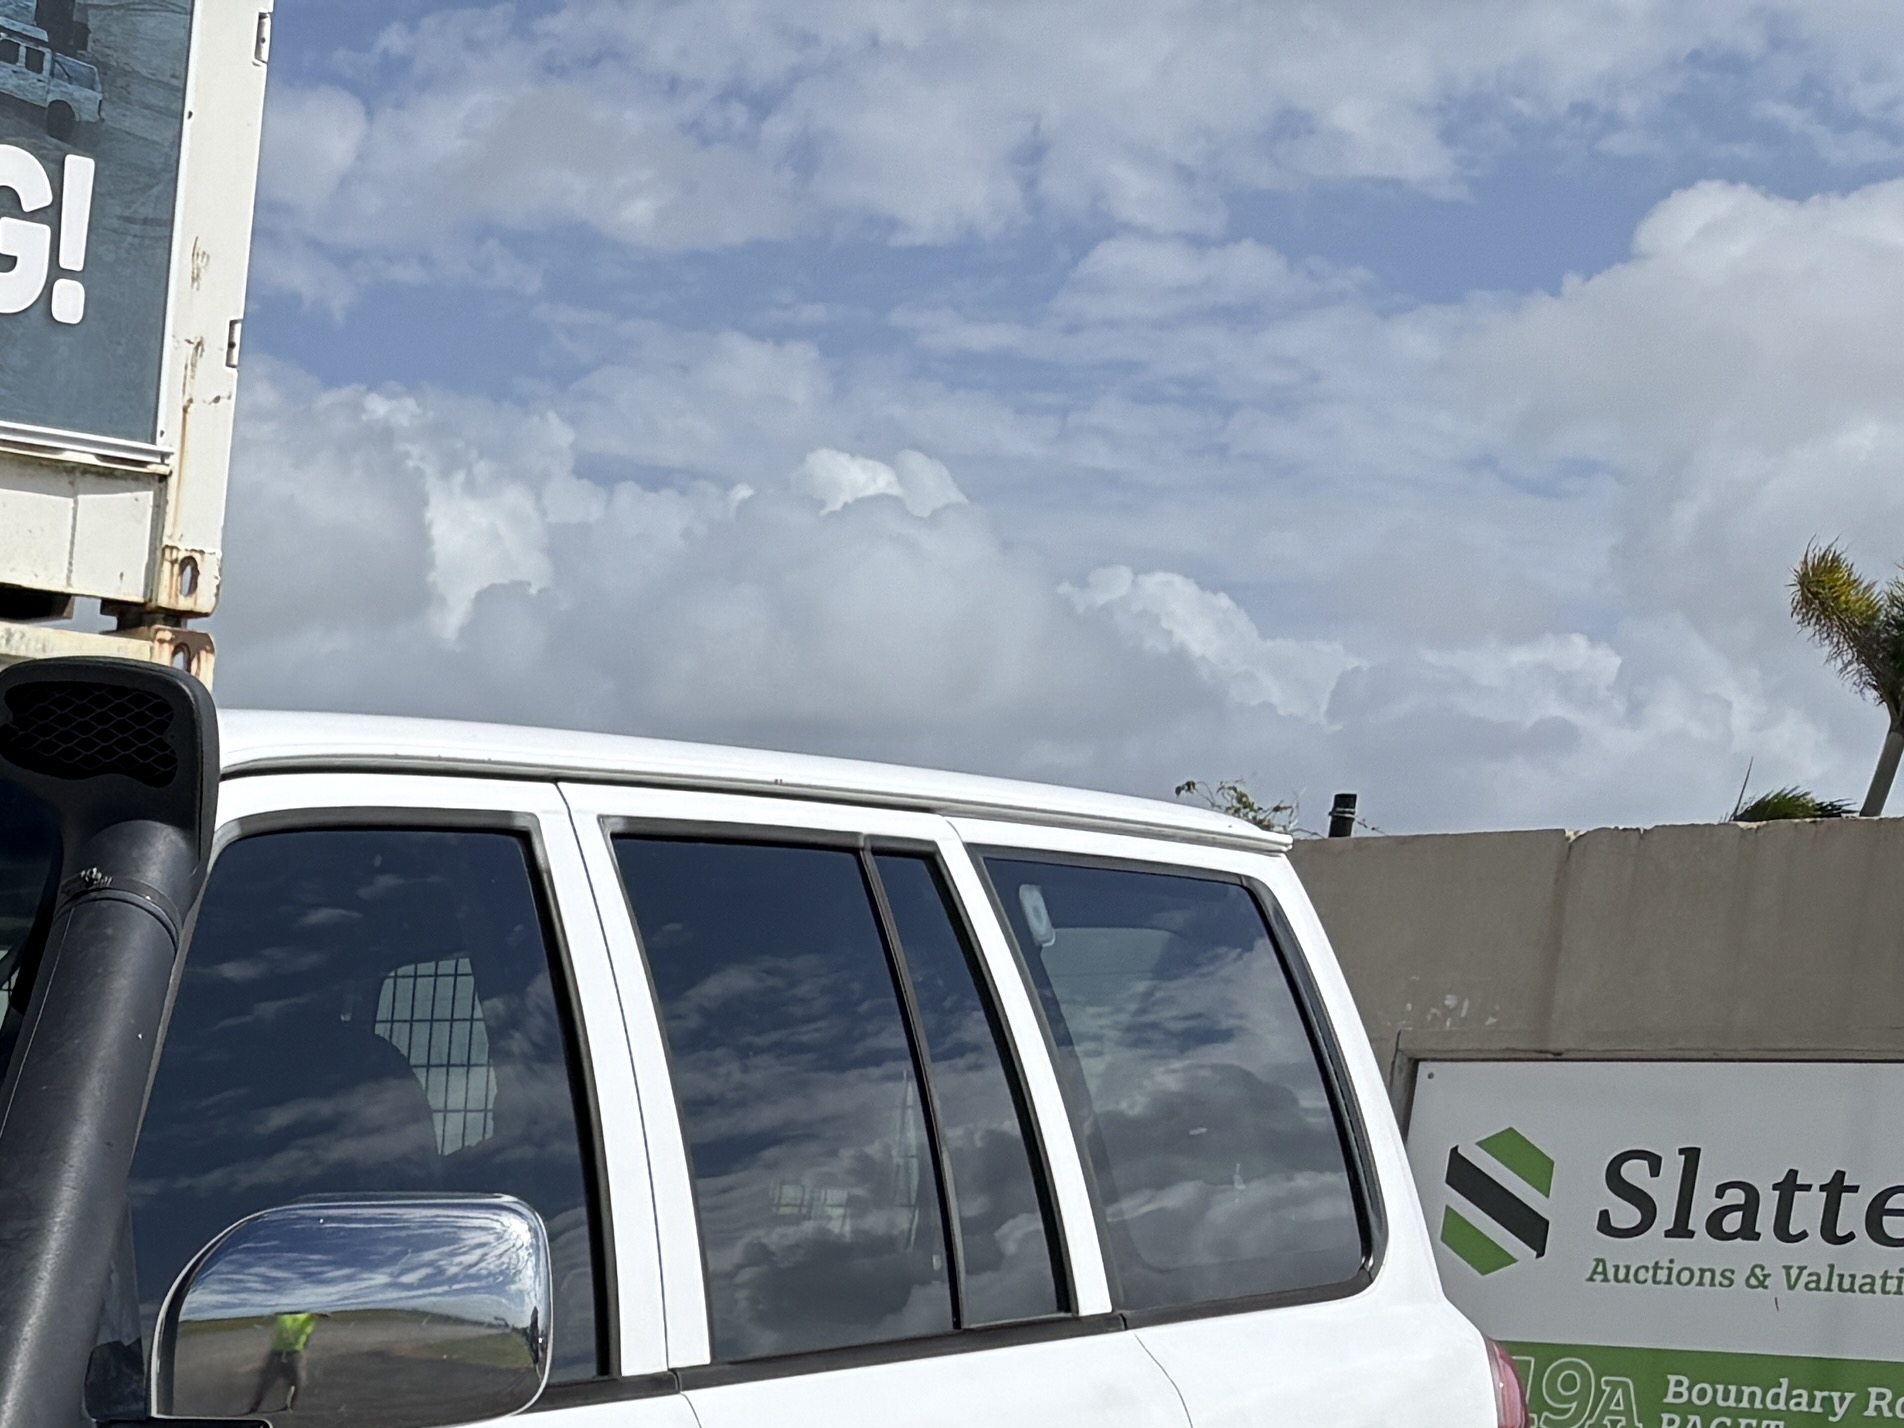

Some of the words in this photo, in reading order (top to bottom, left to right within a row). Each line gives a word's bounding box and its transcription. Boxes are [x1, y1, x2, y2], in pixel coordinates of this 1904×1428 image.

[1585, 1256, 1735, 1290] Auctions
[1744, 1263, 1770, 1289] &
[1663, 1374, 1857, 1423] Boundary
